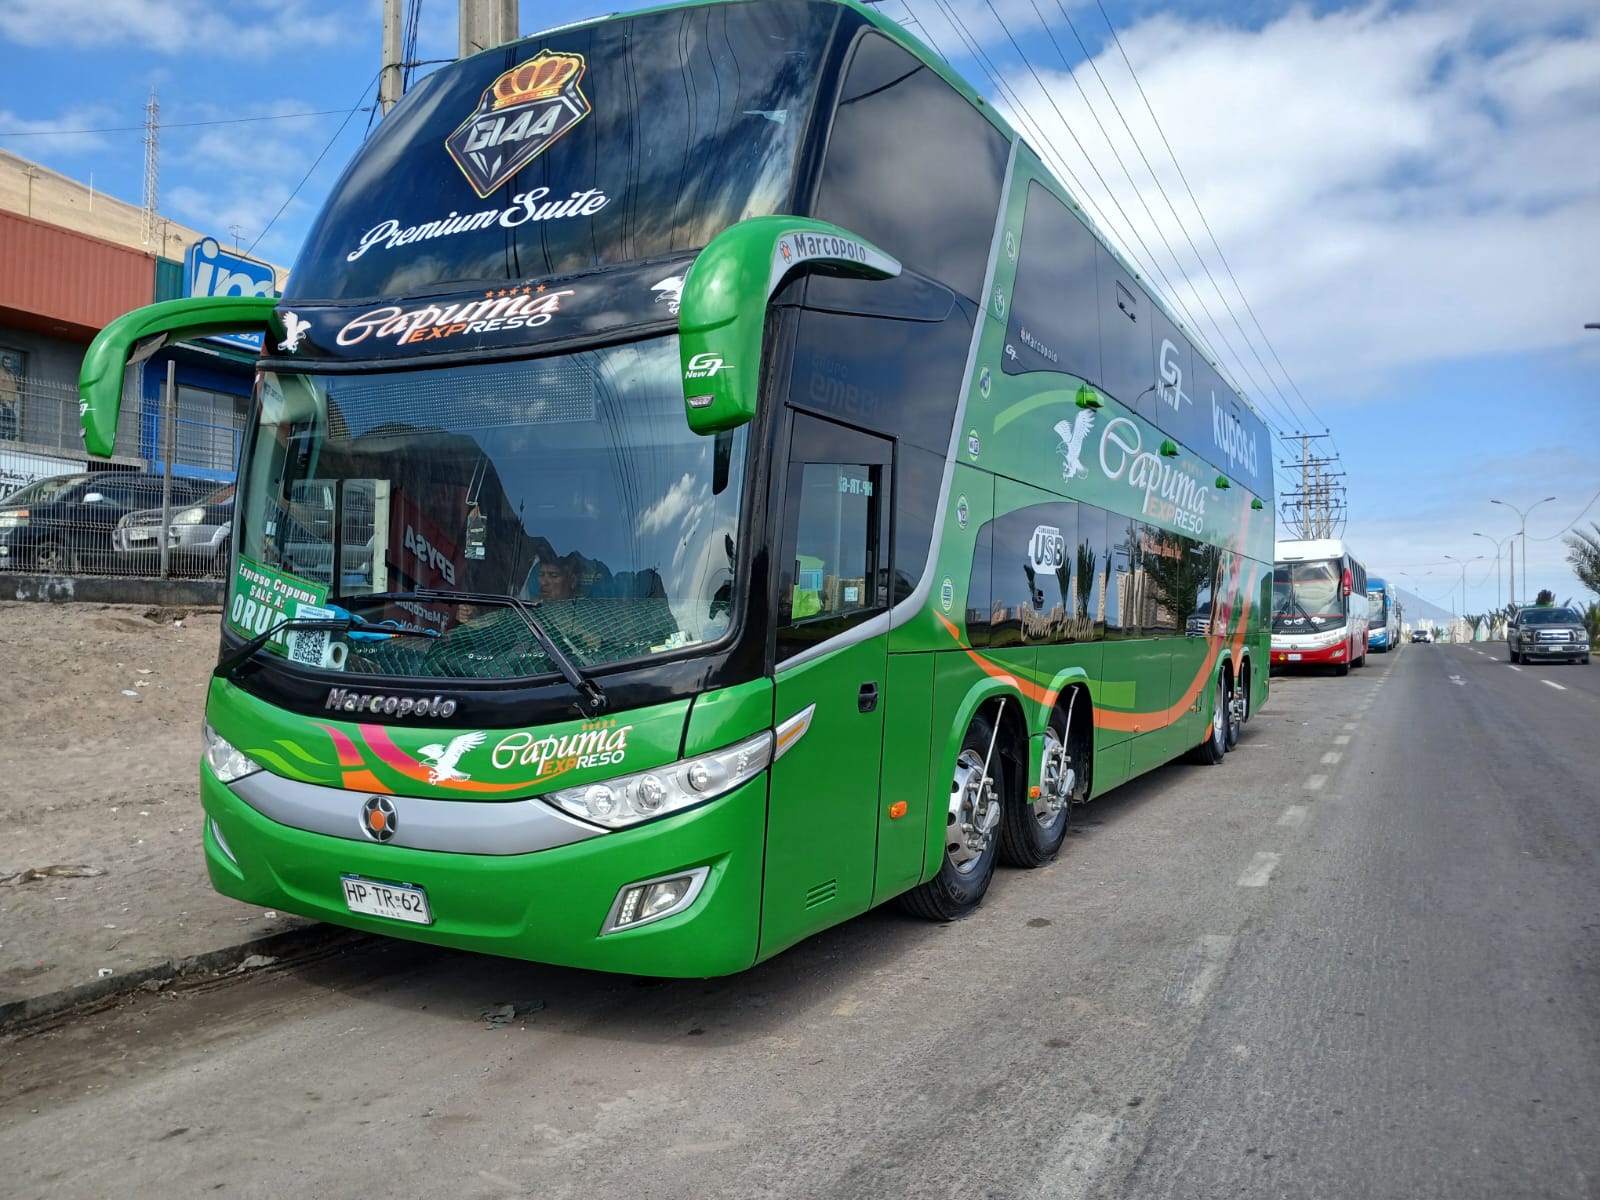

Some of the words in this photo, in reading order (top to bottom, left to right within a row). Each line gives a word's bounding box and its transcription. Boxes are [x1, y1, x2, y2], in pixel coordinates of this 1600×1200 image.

[462, 103, 563, 153] GIAA
[347, 210, 502, 262] Premium
[499, 187, 611, 228] Suite
[794, 233, 867, 262] Marcopolo
[336, 290, 576, 346] Capuma
[409, 313, 552, 343] EXPRESO
[1023, 330, 1059, 363] Marcopolo
[685, 370, 708, 379] New
[1099, 416, 1210, 515] Capuma
[1149, 497, 1204, 535] EXPRESO
[1034, 533, 1064, 566] USB
[239, 563, 271, 587] Expreso
[273, 579, 317, 605] Capuma
[249, 585, 273, 604] SALE
[274, 595, 285, 609] A:
[231, 593, 293, 648] ORUR
[324, 687, 457, 718] Marcopolo
[491, 725, 633, 776] Capuma
[542, 750, 625, 775] EXPRESO
